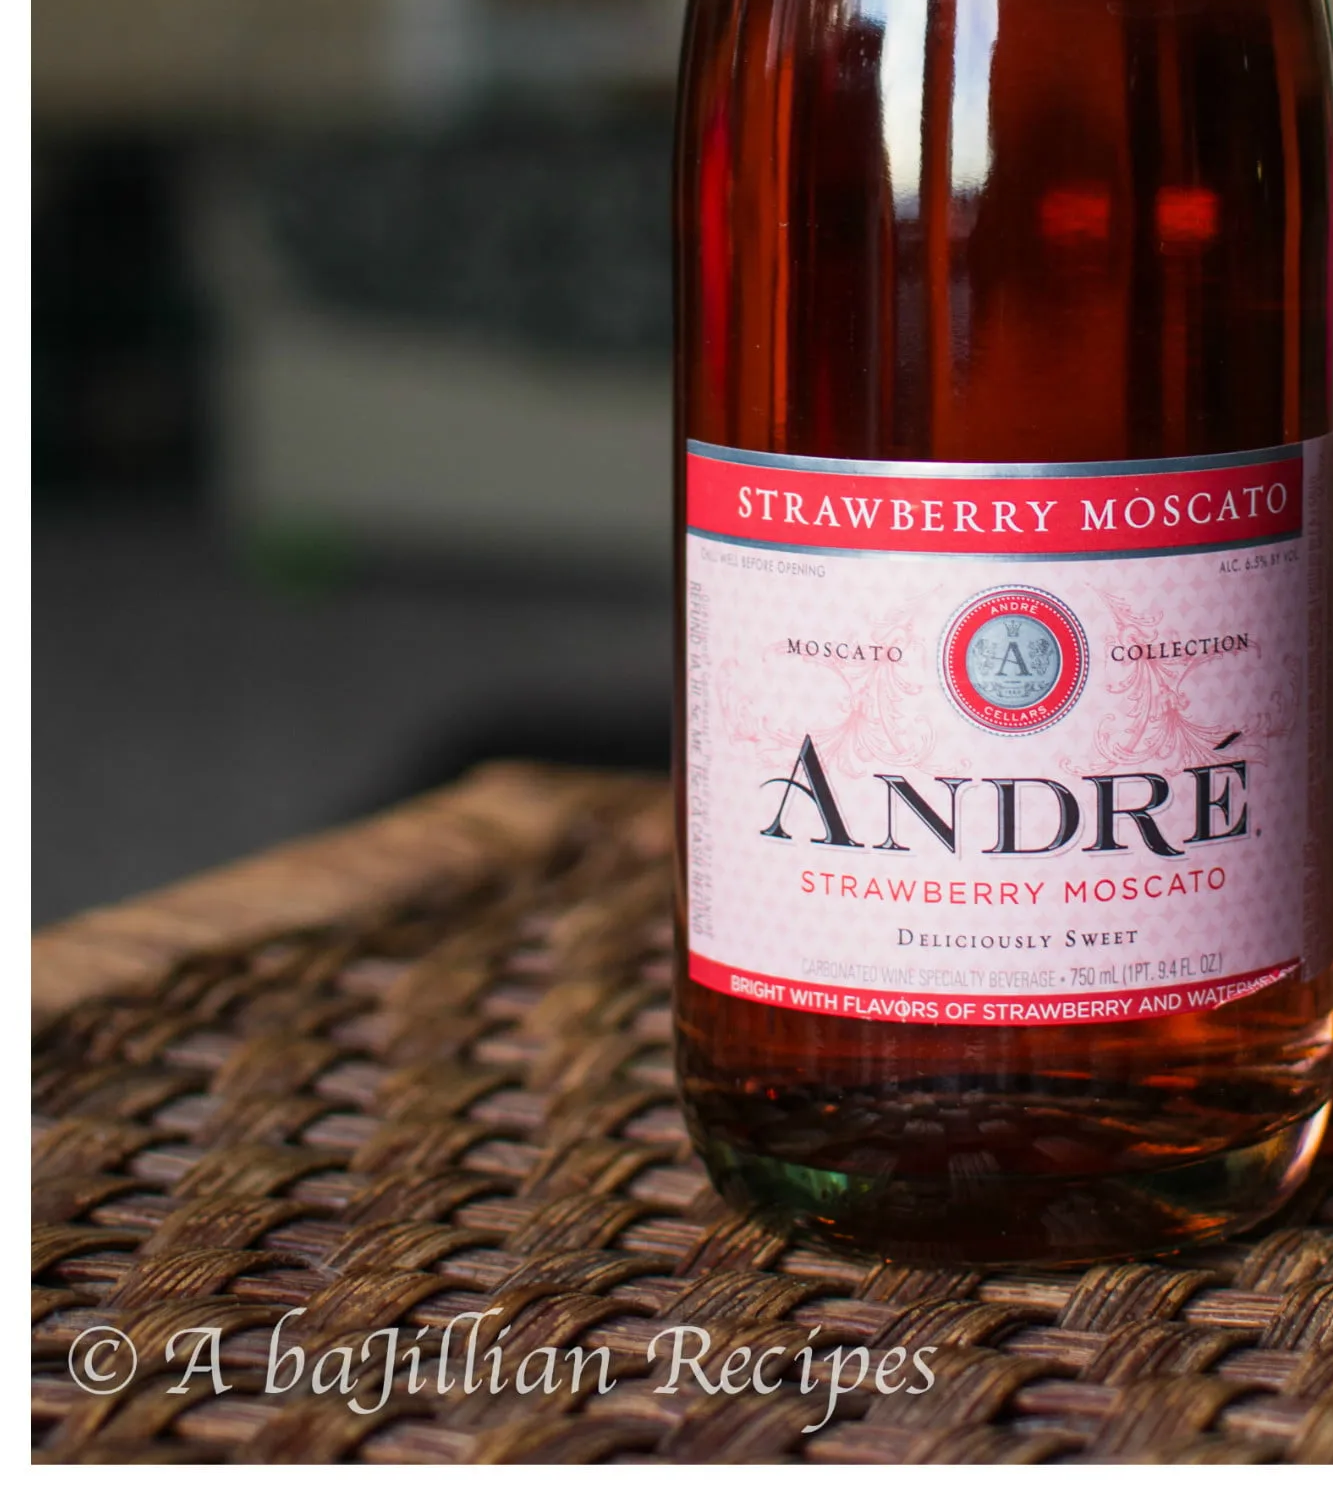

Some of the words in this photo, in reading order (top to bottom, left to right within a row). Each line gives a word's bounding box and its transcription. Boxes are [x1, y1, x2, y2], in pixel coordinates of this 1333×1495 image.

[738, 485, 1058, 533] STRAWBERRY
[1080, 482, 1287, 531] MOSCATO
[741, 555, 774, 573] BEFORE
[777, 560, 826, 578] OPENING
[990, 601, 1038, 615] ANDRÉ
[787, 637, 903, 662] MOSCATO
[1111, 632, 1250, 662] COLLECTION
[995, 641, 1032, 676] A
[983, 705, 1047, 722] CELLARS
[759, 732, 1249, 857] ANDRÉ
[801, 870, 1045, 905] STRAWBERRY
[1065, 867, 1226, 903] MOSCATO
[897, 928, 1051, 949] DELICIOUSLY
[1065, 929, 1139, 948] SWEET
[801, 958, 877, 983] CARBONATED
[881, 967, 914, 985] WINE
[918, 969, 986, 987] SPECIALTY
[988, 969, 1056, 988] BEVERAGE
[1071, 967, 1095, 986] 750
[1100, 964, 1118, 984] mL
[1158, 960, 1177, 979] 9.4
[730, 974, 785, 1002] BRIGHT
[790, 987, 838, 1011] WITH
[843, 995, 939, 1019] FLAVORS
[945, 1001, 976, 1020] OF
[983, 998, 1133, 1021] STRAWBERRY
[1138, 993, 1182, 1014] AND
